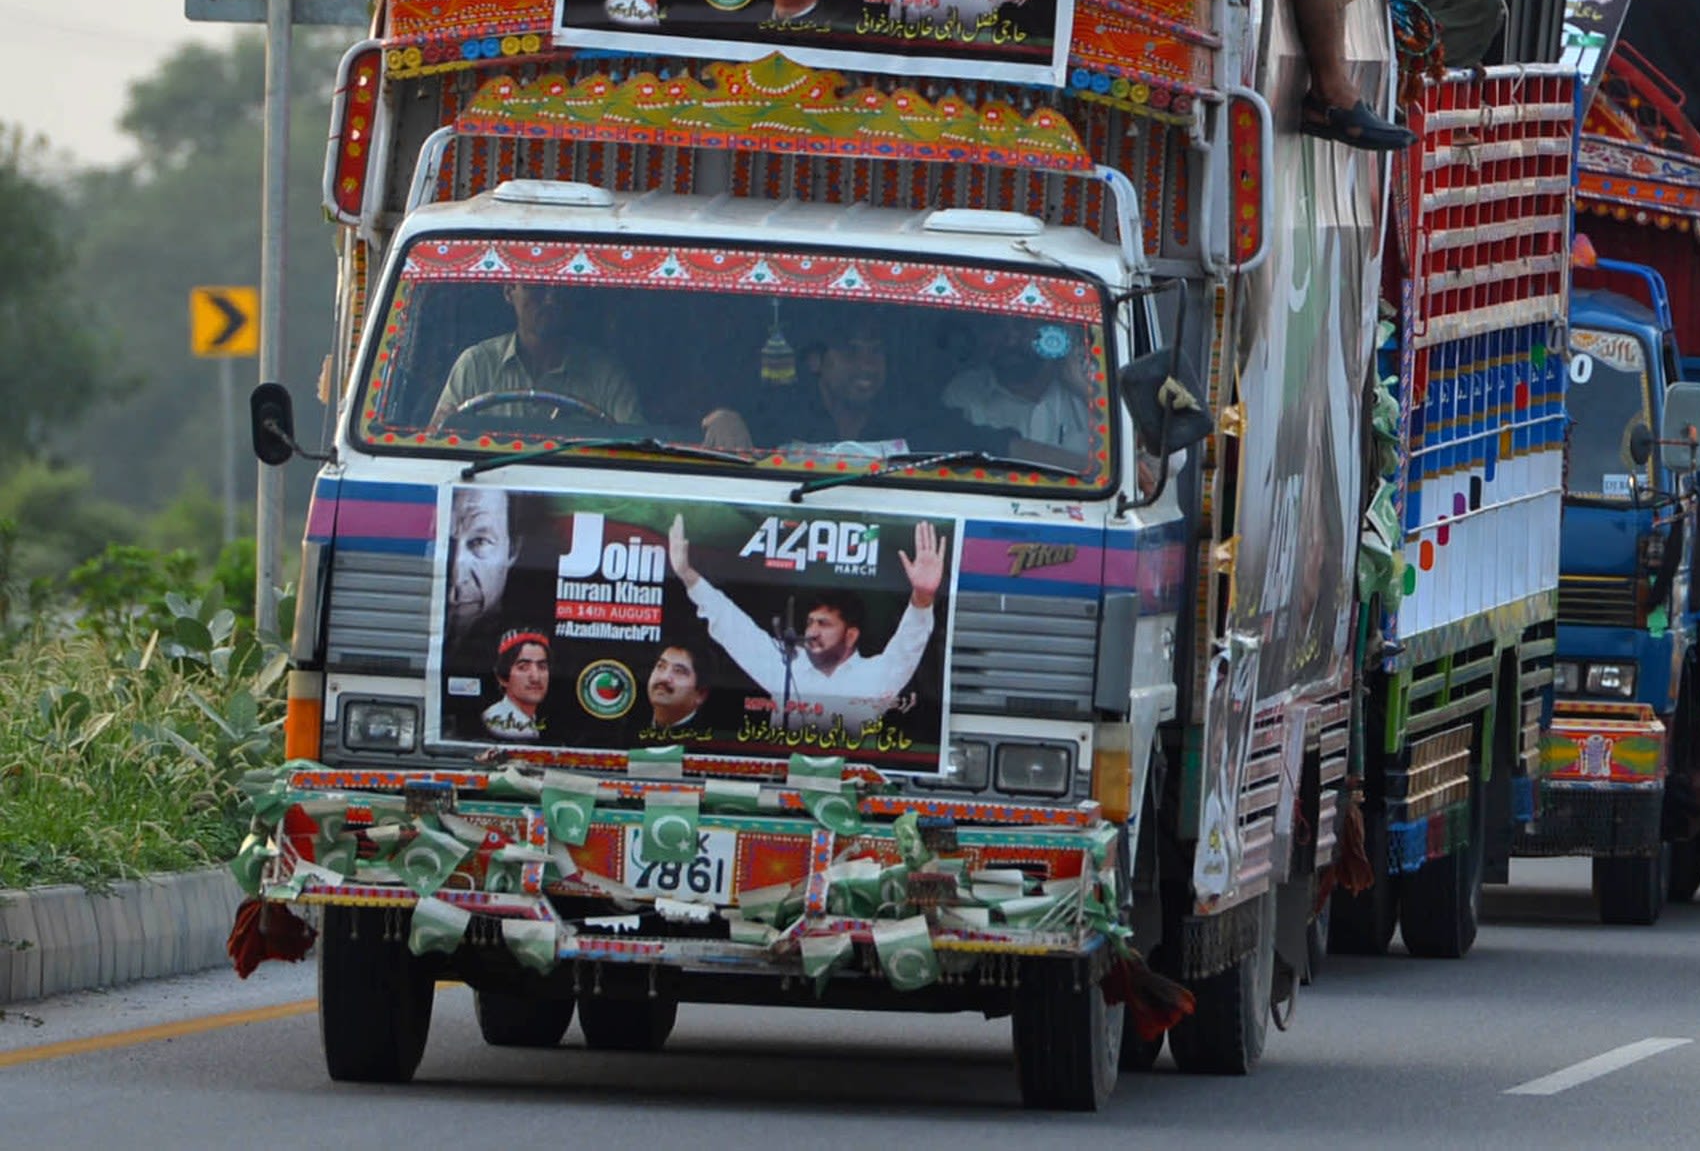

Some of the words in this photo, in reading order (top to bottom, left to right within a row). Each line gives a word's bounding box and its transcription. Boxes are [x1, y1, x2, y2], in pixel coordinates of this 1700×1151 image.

[904, 15, 933, 38] خان
[961, 8, 998, 42] فضل
[993, 19, 1027, 44] حاجی
[558, 511, 666, 582] Join
[739, 516, 880, 571] AZADI
[834, 564, 878, 578] MARCH
[556, 578, 612, 602] Imran
[615, 581, 663, 606] Khan
[556, 605, 573, 616] on
[610, 606, 660, 620] AUGUST
[555, 620, 661, 642] #AzadiMarchPTI
[786, 724, 818, 746] خان
[847, 715, 883, 750] فضل
[878, 727, 913, 752] حاجی
